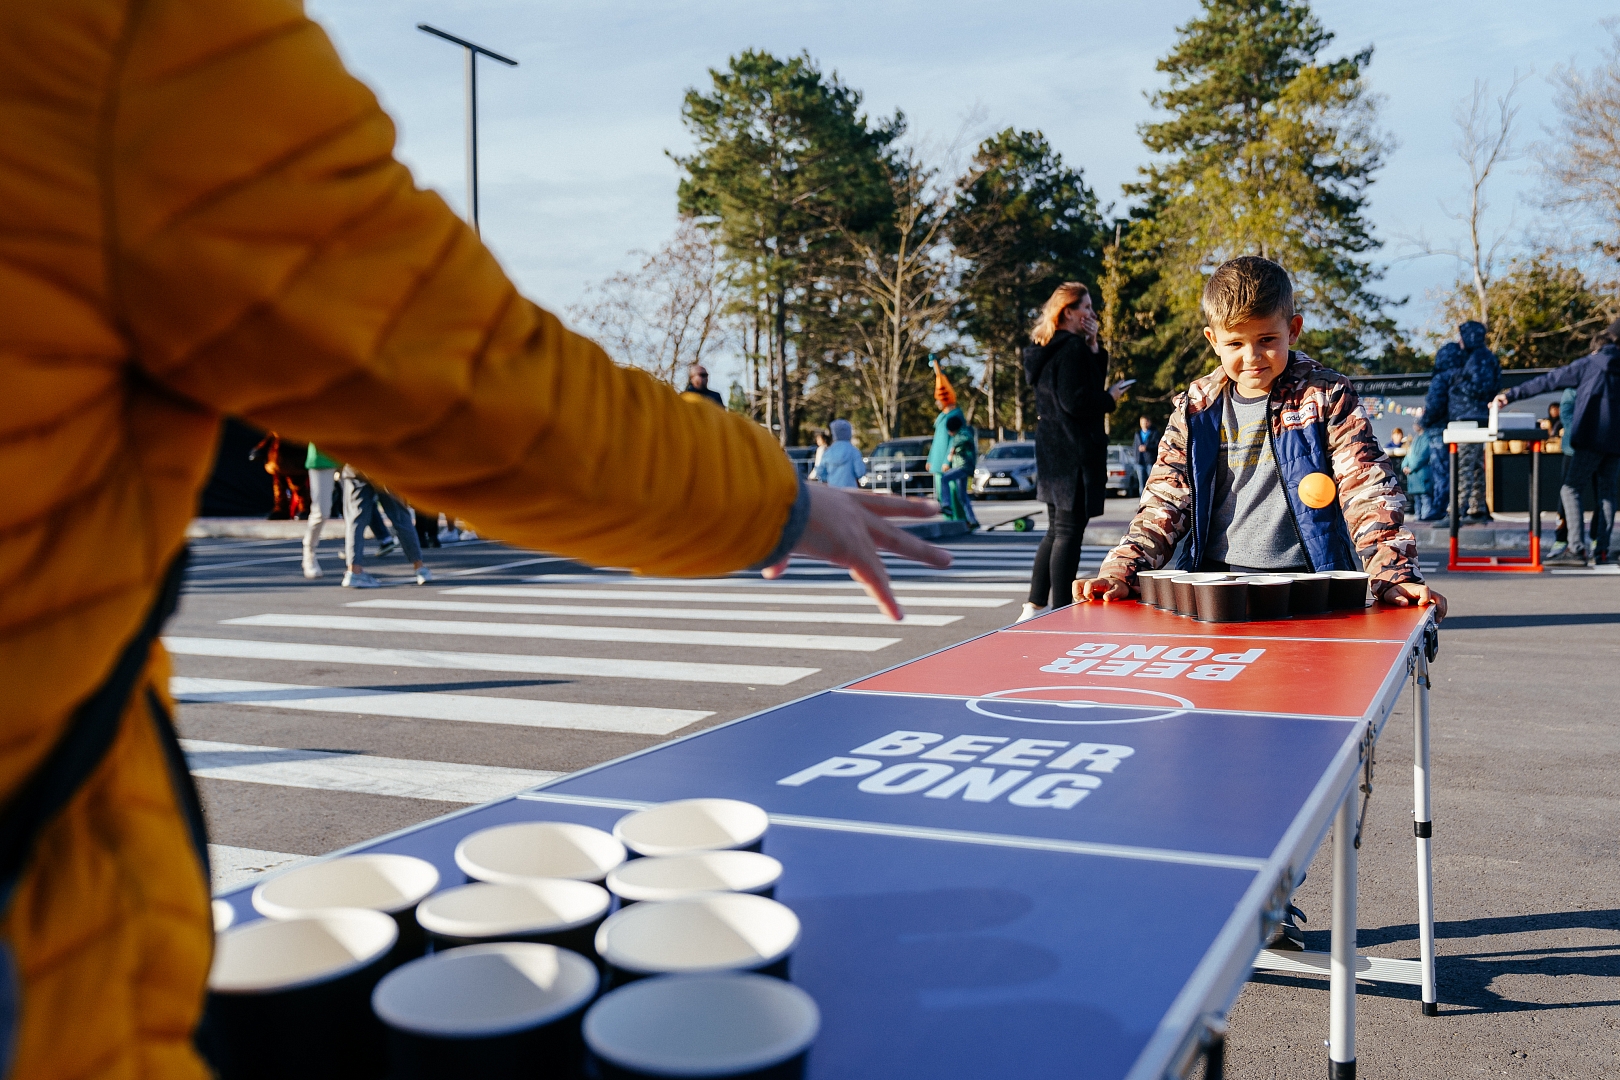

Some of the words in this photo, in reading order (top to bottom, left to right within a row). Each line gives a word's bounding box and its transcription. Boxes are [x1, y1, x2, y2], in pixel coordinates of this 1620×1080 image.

[1040, 657, 1246, 682] BEER
[1066, 643, 1266, 663] PONG
[850, 730, 1135, 773] BEER
[776, 756, 1102, 810] PONG
